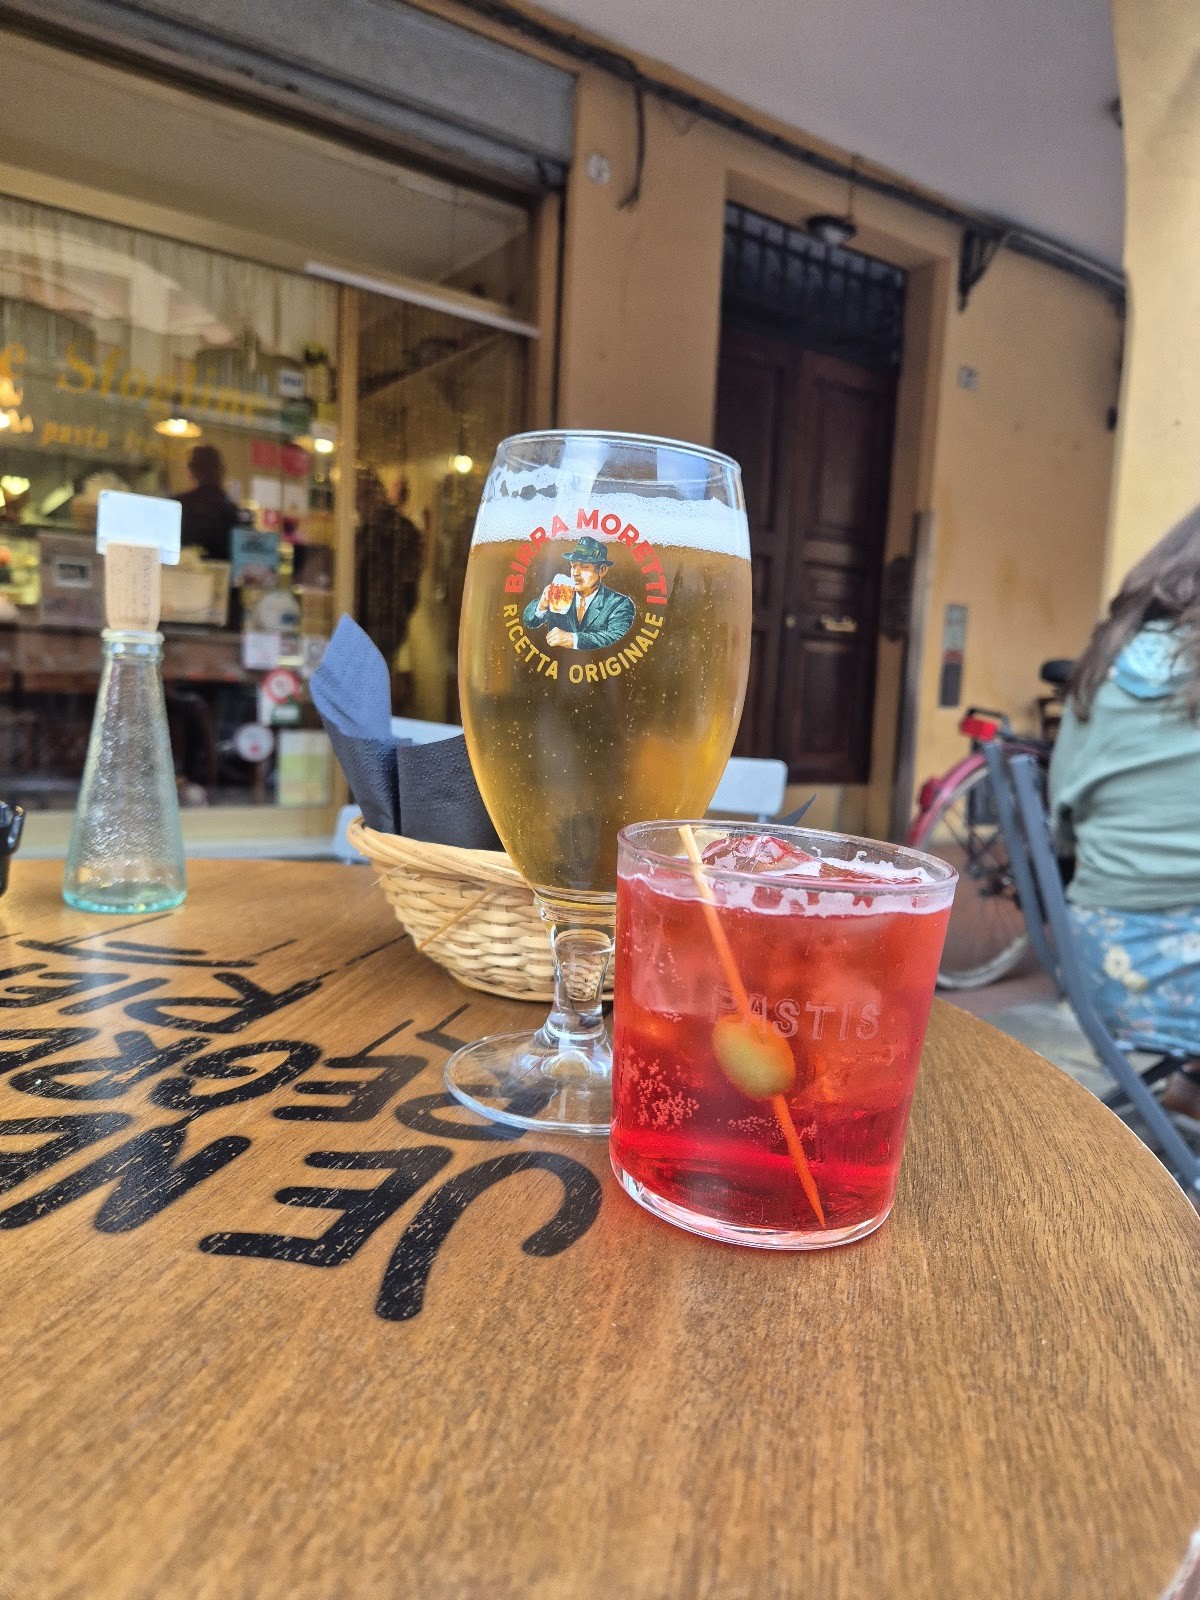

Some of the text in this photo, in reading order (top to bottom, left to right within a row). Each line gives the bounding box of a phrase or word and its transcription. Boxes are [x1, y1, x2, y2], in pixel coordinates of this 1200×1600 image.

[504, 508, 668, 605] BIRRA MORETTI
[503, 604, 664, 684] RICETTA ORIGINALE
[0, 962, 326, 1034] RIE
[709, 984, 881, 1041] PASTIS
[199, 1145, 601, 1322] JE
